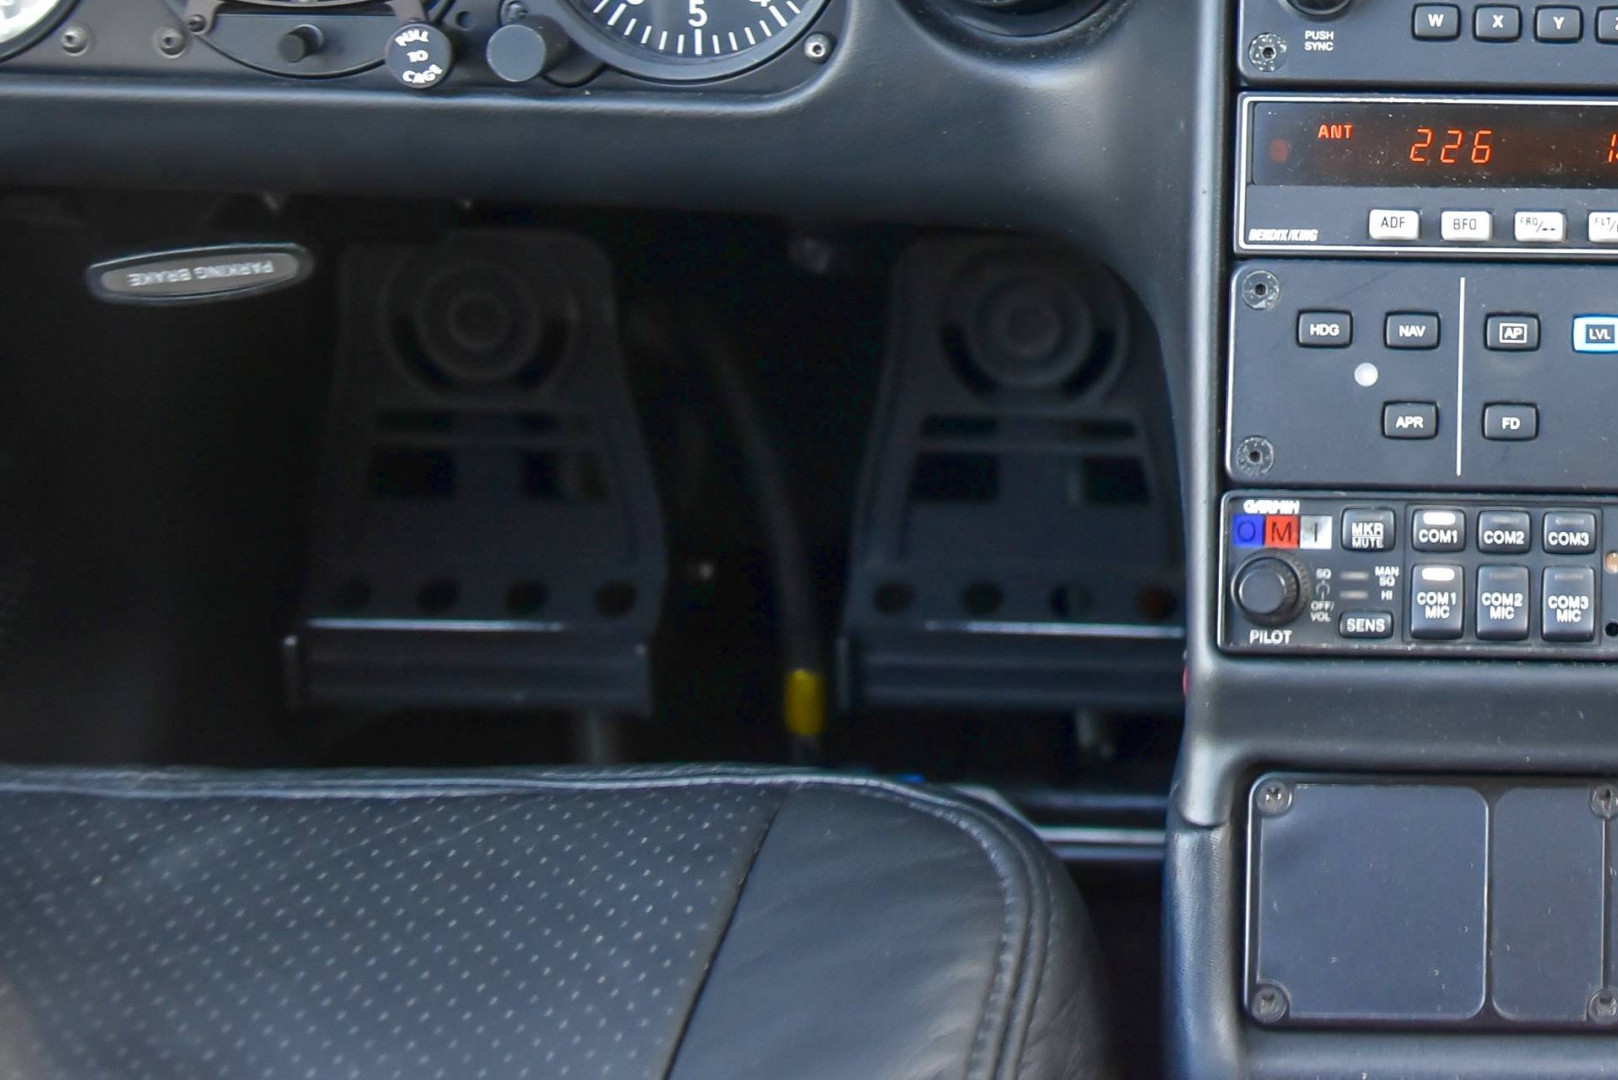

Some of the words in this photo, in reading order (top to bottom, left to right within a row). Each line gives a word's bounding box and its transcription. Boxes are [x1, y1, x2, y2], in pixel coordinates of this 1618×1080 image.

[688, 0, 707, 27] 5
[1304, 31, 1334, 40] PUSH
[1304, 42, 1334, 51] SYNC
[406, 50, 429, 62] TO
[1318, 124, 1352, 139] ANT
[1410, 129, 1492, 164] 226
[1381, 217, 1405, 229] ADF
[1453, 219, 1477, 230] BFO
[1310, 324, 1340, 337] HDG
[1399, 325, 1426, 337] NAV
[1504, 327, 1523, 339] AP
[1589, 329, 1611, 340] LVL
[1396, 415, 1423, 428] APR
[1502, 417, 1520, 430] FD
[1272, 522, 1292, 542] M
[1352, 523, 1384, 536] MKR
[1419, 529, 1458, 543] COM1
[1352, 537, 1384, 548] MUTE
[1484, 531, 1524, 544] COM2
[1548, 532, 1589, 546] COM3
[1482, 592, 1523, 606] COM2
[1548, 596, 1588, 609] COM3
[1425, 605, 1449, 619] MIC
[1490, 606, 1514, 619] MIC
[1557, 609, 1581, 623] MIC
[1347, 619, 1385, 632] SENS
[1250, 630, 1292, 644] PILOT
